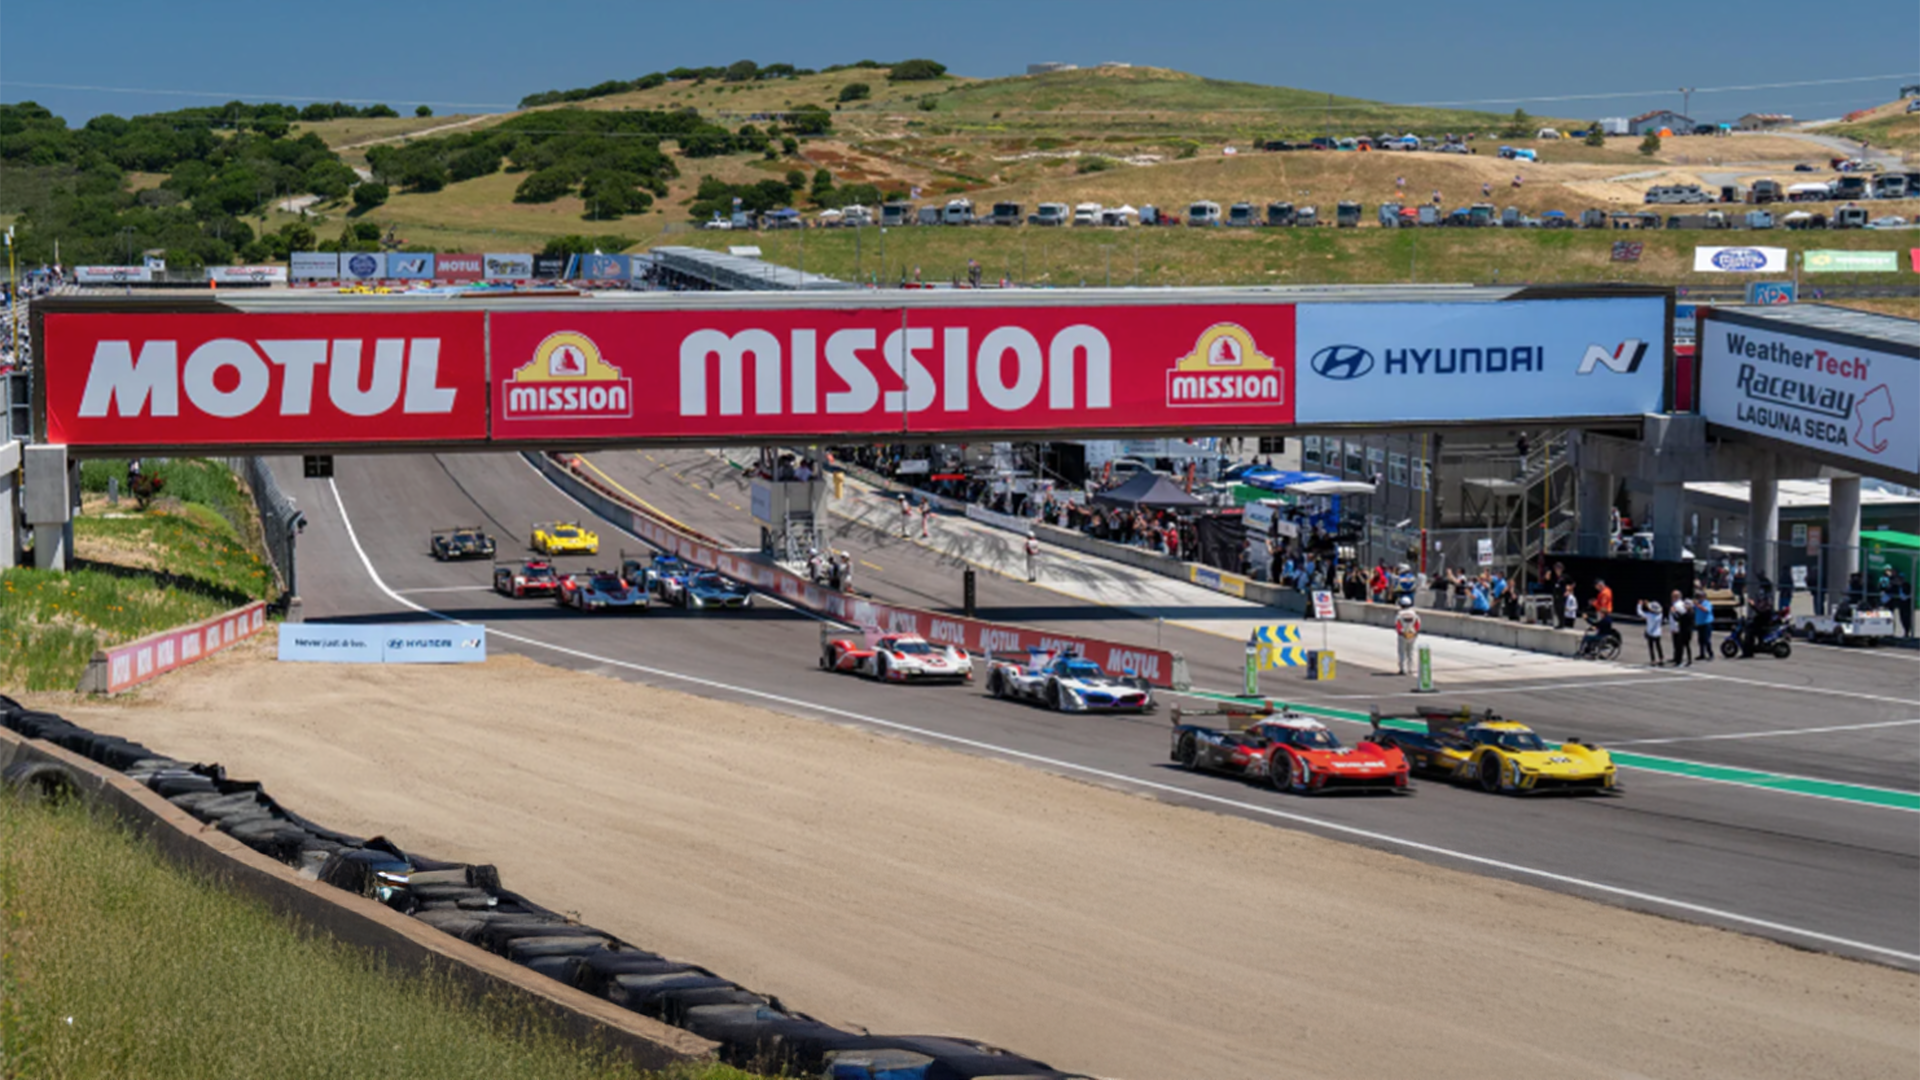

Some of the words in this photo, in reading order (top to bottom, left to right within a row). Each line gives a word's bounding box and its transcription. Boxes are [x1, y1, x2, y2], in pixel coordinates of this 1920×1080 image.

[437, 259, 480, 272] MOTUL
[679, 324, 1111, 416] MISSION
[1385, 346, 1543, 375] HYUNDAI
[77, 337, 457, 418] MOTUL
[1171, 374, 1278, 400] MISSION
[1737, 363, 1855, 420] Raceway
[508, 385, 626, 412] MISSION
[1737, 402, 1802, 436] LAGUNA
[1804, 418, 1849, 446] SECA
[930, 618, 964, 645] MOTUL
[979, 628, 1020, 652] MOTUL
[1107, 648, 1160, 680] MOTUL
